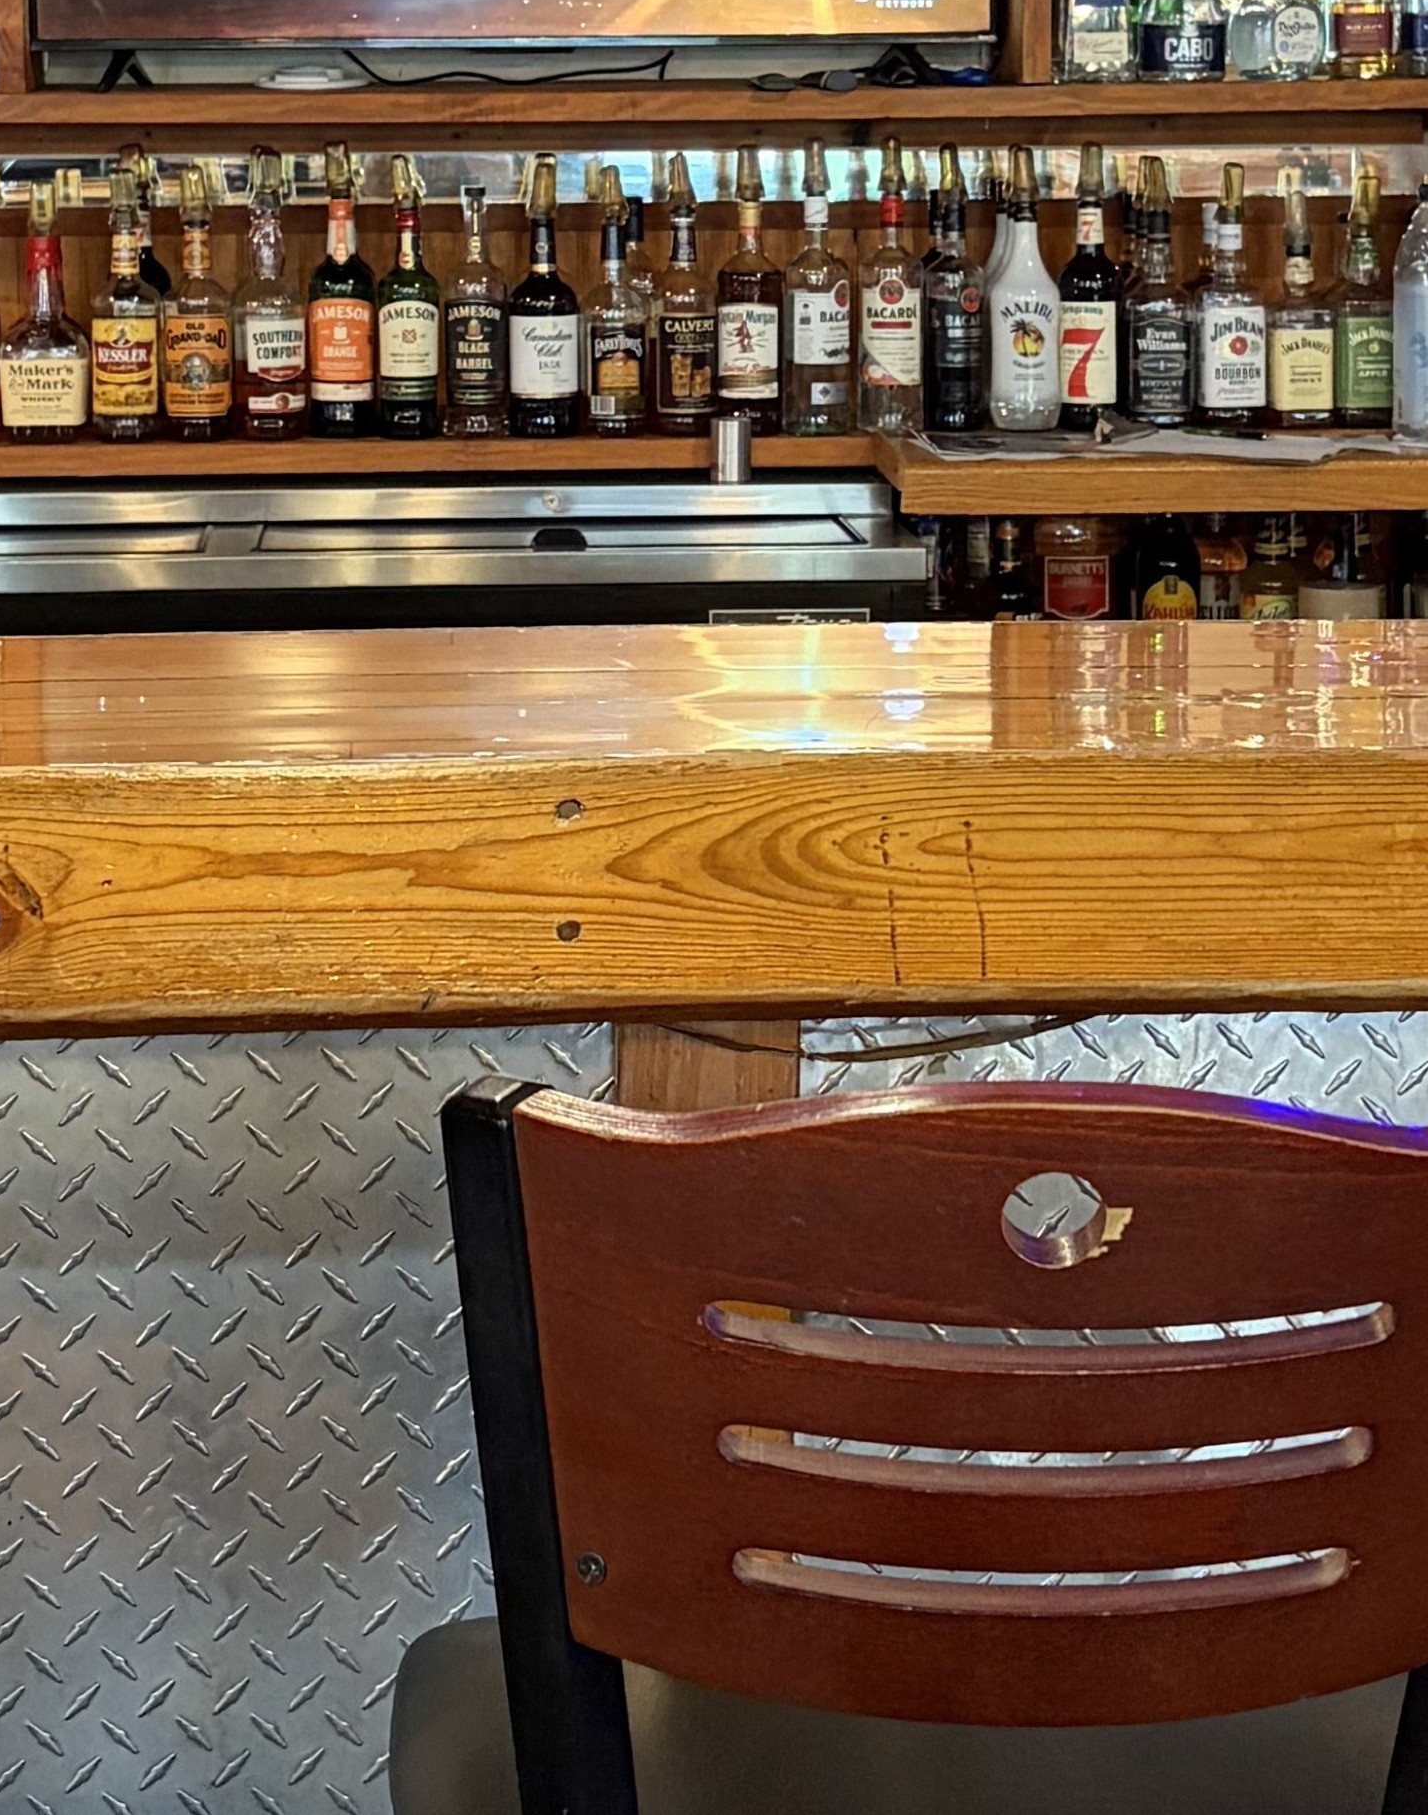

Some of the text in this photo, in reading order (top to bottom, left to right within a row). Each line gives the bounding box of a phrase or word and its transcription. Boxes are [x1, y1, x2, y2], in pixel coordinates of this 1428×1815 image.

[875, 0, 933, 9] NETWORK
[1164, 37, 1214, 62] CABO
[1081, 220, 1093, 241] 7
[311, 305, 369, 323] JAMESON
[381, 306, 436, 324] JAMESON
[447, 305, 501, 321] JAMESON
[1001, 301, 1053, 323] MALIBU
[185, 322, 204, 331] OLD
[664, 319, 714, 333] CALVERT
[1146, 328, 1177, 339] Evan
[1210, 317, 1265, 342] JIM BEAM
[522, 326, 572, 343] Canadian
[1349, 331, 1368, 346] JACK
[323, 346, 357, 357] ORANGE
[458, 341, 490, 353] BLACK
[533, 342, 563, 358] Club
[1136, 339, 1187, 351] Williams
[1282, 342, 1300, 357] JACK
[98, 347, 148, 363] KESSLER
[256, 346, 302, 360] COMFORT
[456, 358, 493, 369] BARREL
[1062, 328, 1106, 398] 7
[9, 365, 74, 378] Maker's
[1215, 367, 1261, 380] BOURBON
[25, 378, 73, 390] Mark
